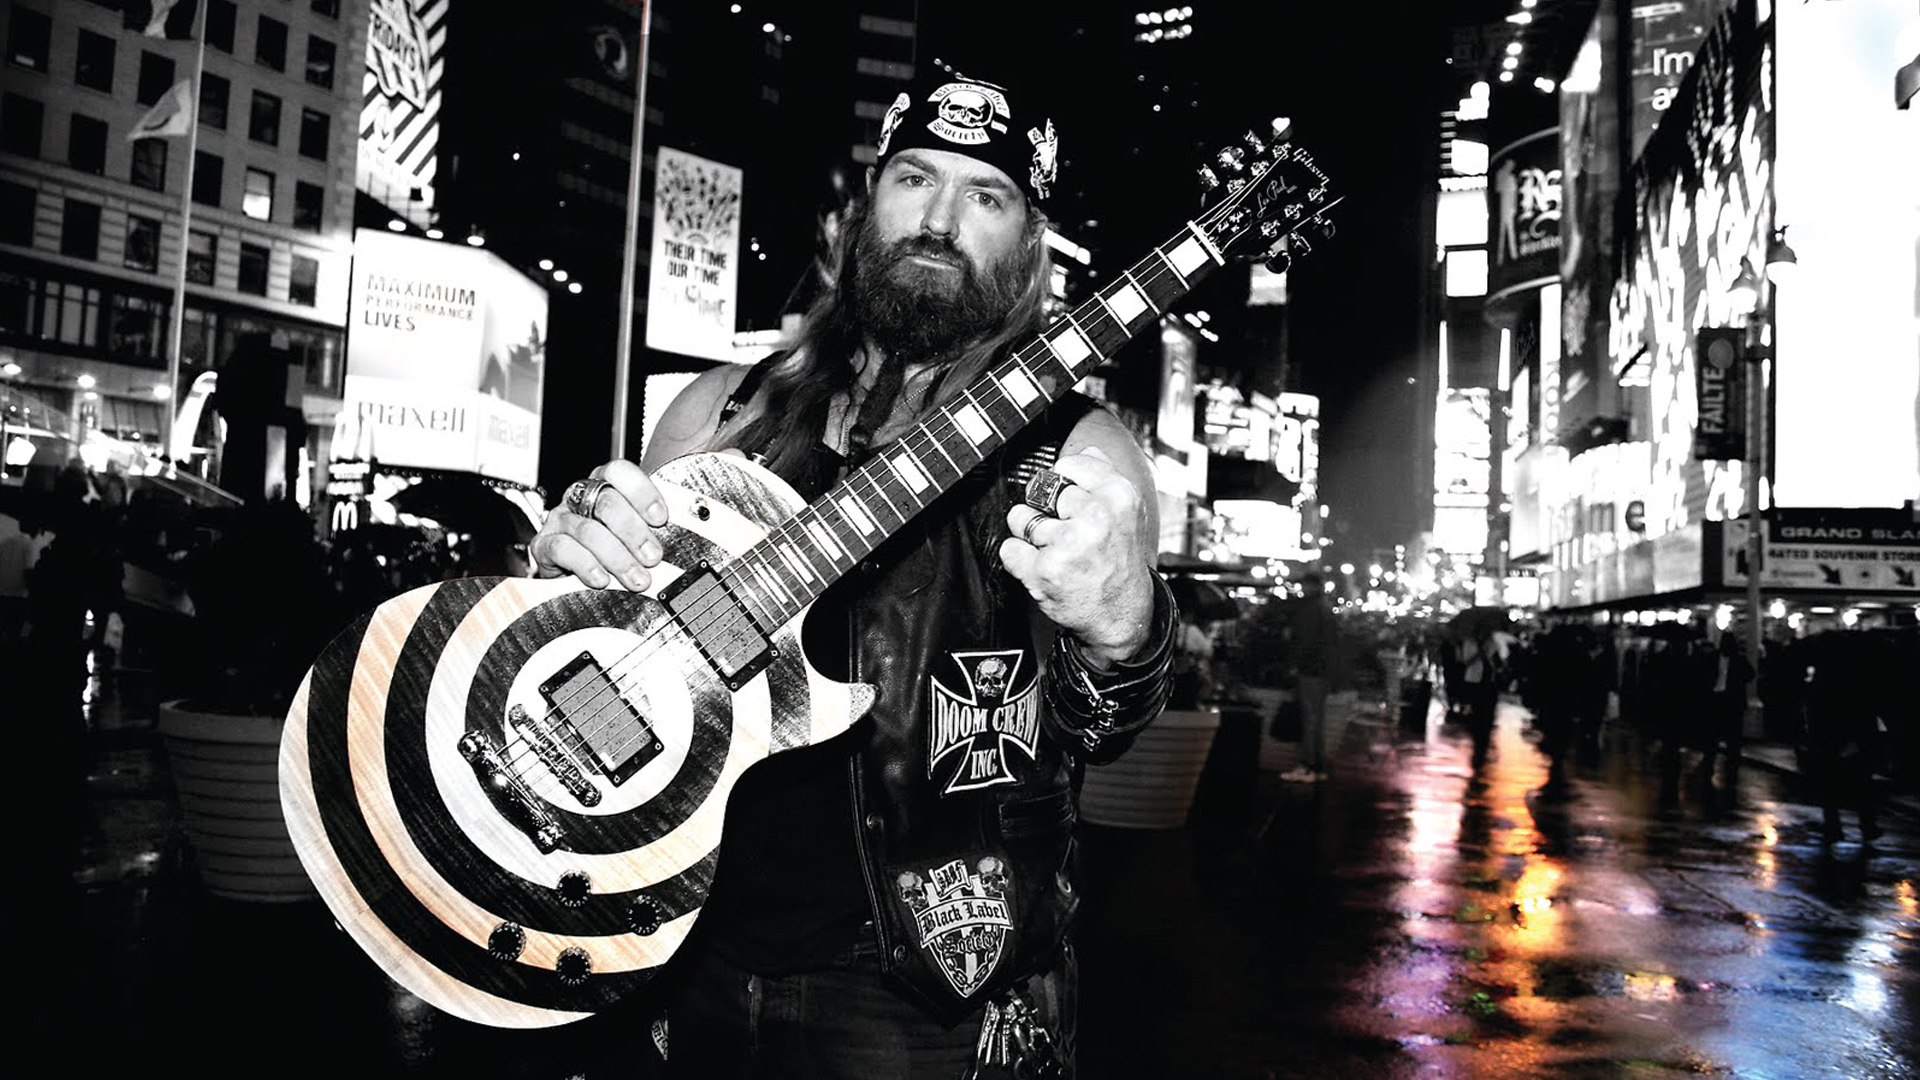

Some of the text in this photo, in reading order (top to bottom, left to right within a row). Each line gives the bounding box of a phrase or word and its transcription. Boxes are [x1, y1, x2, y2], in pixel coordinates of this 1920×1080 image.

[1293, 147, 1330, 187] Gibson
[663, 239, 727, 270] THEIR TIME
[367, 273, 475, 307] MAXIMUM
[364, 309, 416, 332] LIVES
[365, 294, 472, 321] PERFORMANCE
[357, 401, 465, 432] maxell
[1780, 526, 1920, 541] GRAND SLA
[1812, 550, 1878, 561] SOUVENIR
[935, 684, 1038, 757] DOOM CREW
[921, 900, 1008, 940] Black Label
